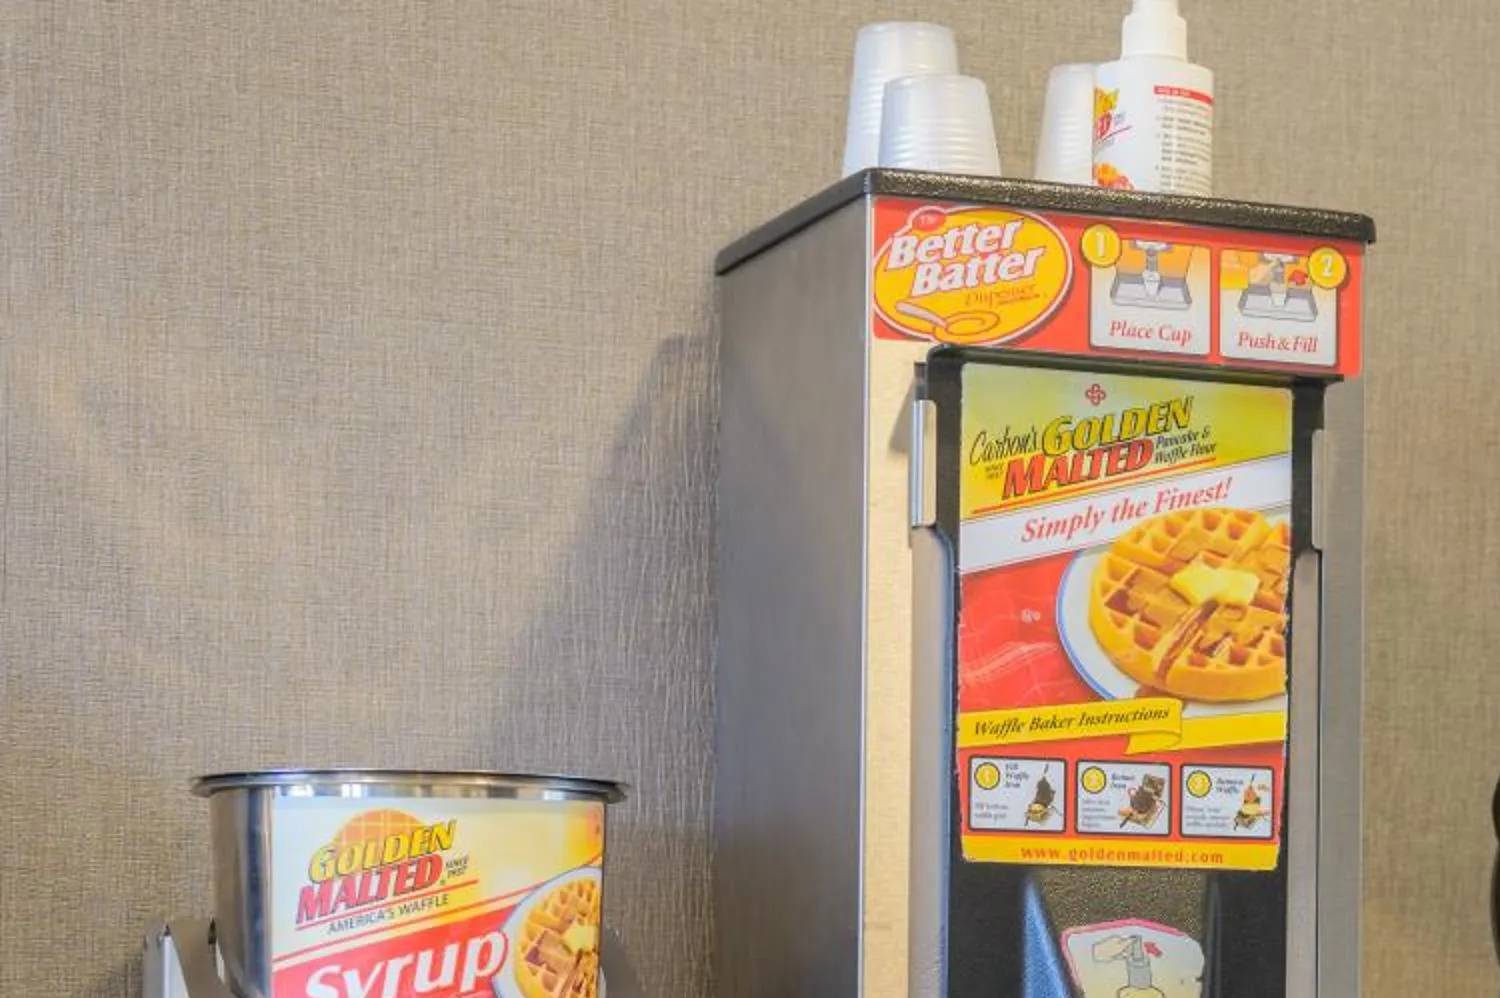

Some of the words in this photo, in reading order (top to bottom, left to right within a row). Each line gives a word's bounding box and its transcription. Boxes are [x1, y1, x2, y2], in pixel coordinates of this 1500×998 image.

[887, 218, 1025, 271] Better
[1095, 231, 1107, 258] 1
[1320, 254, 1334, 277] 2
[911, 246, 1047, 297] Batter
[1109, 319, 1153, 342] Place
[1158, 324, 1193, 347] Cup
[1042, 397, 1194, 457] GOLDEN
[1002, 438, 1154, 501] MALTED
[1020, 507, 1106, 542] Simply
[1111, 491, 1148, 524] the
[1152, 476, 1233, 514] Finest!
[974, 714, 1026, 740] Waffle
[1028, 709, 1075, 732] Baker
[1077, 705, 1171, 728] Instructions
[309, 819, 457, 884] GOLDEN
[295, 853, 444, 924] MALTED
[327, 909, 396, 935] AMERICA'S
[398, 893, 449, 918] WAFFLE
